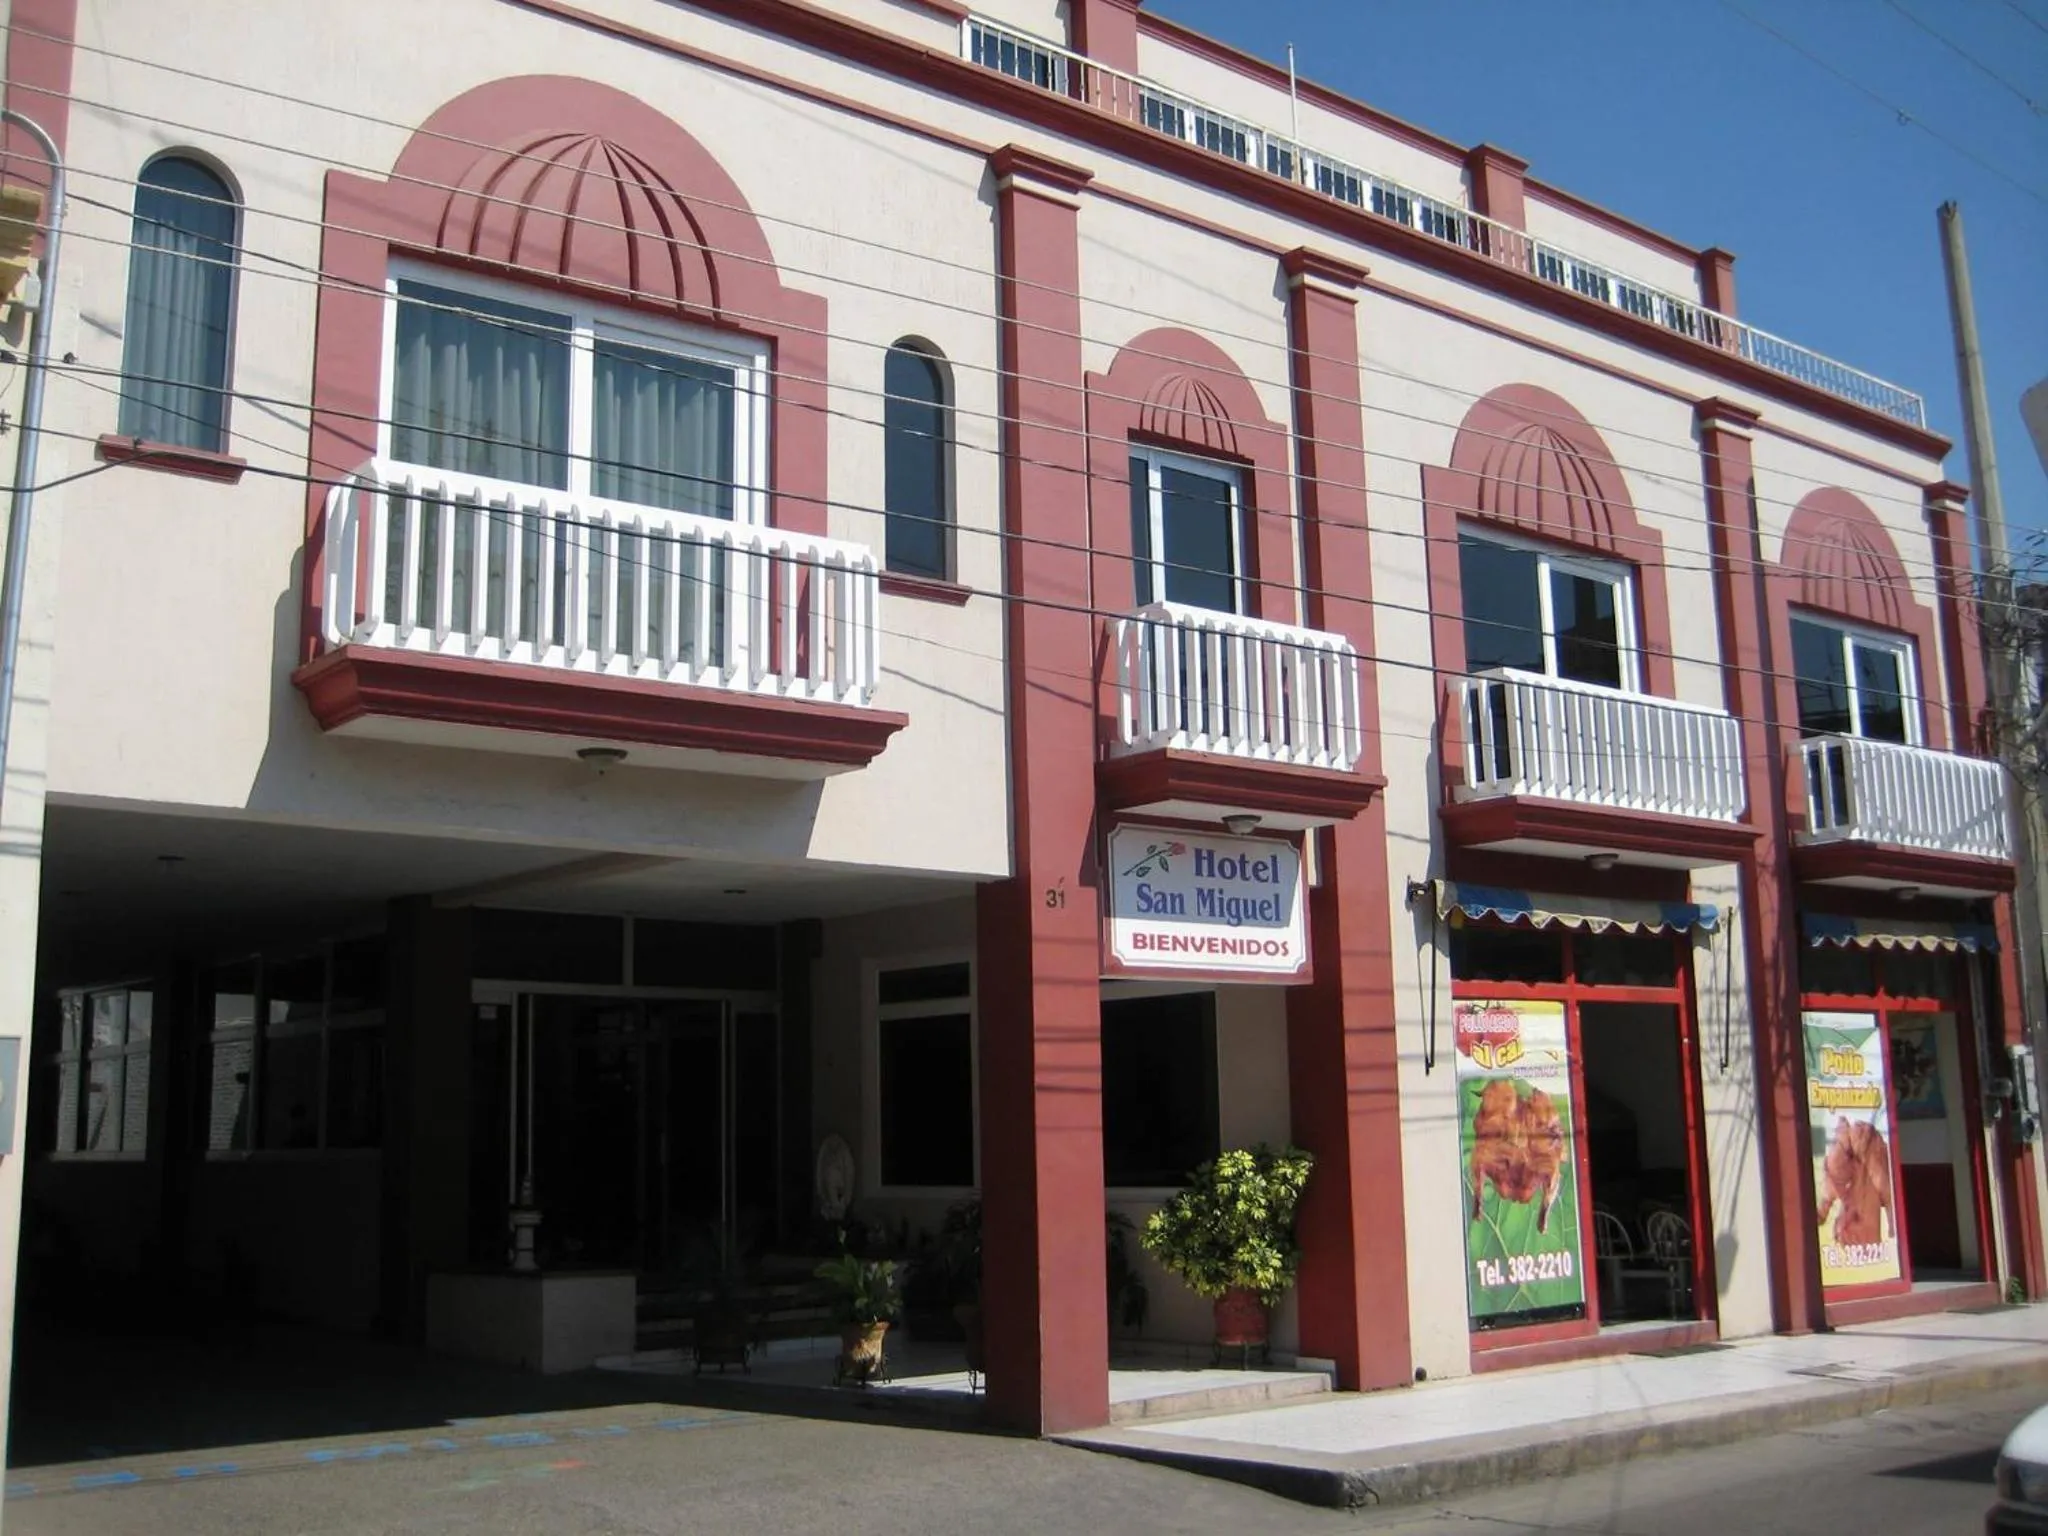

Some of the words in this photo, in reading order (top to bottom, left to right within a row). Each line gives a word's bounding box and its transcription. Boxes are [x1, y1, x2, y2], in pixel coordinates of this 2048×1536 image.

[1193, 847, 1279, 884] Hotel
[1046, 889, 1065, 909] 31
[1136, 883, 1186, 916] San
[1196, 887, 1281, 927] Miguel
[1132, 932, 1290, 957] BIENVENIDOS
[1821, 1045, 1864, 1076] Pollo
[1476, 1258, 1505, 1287] Tel.
[1508, 1251, 1572, 1283] 382-2210
